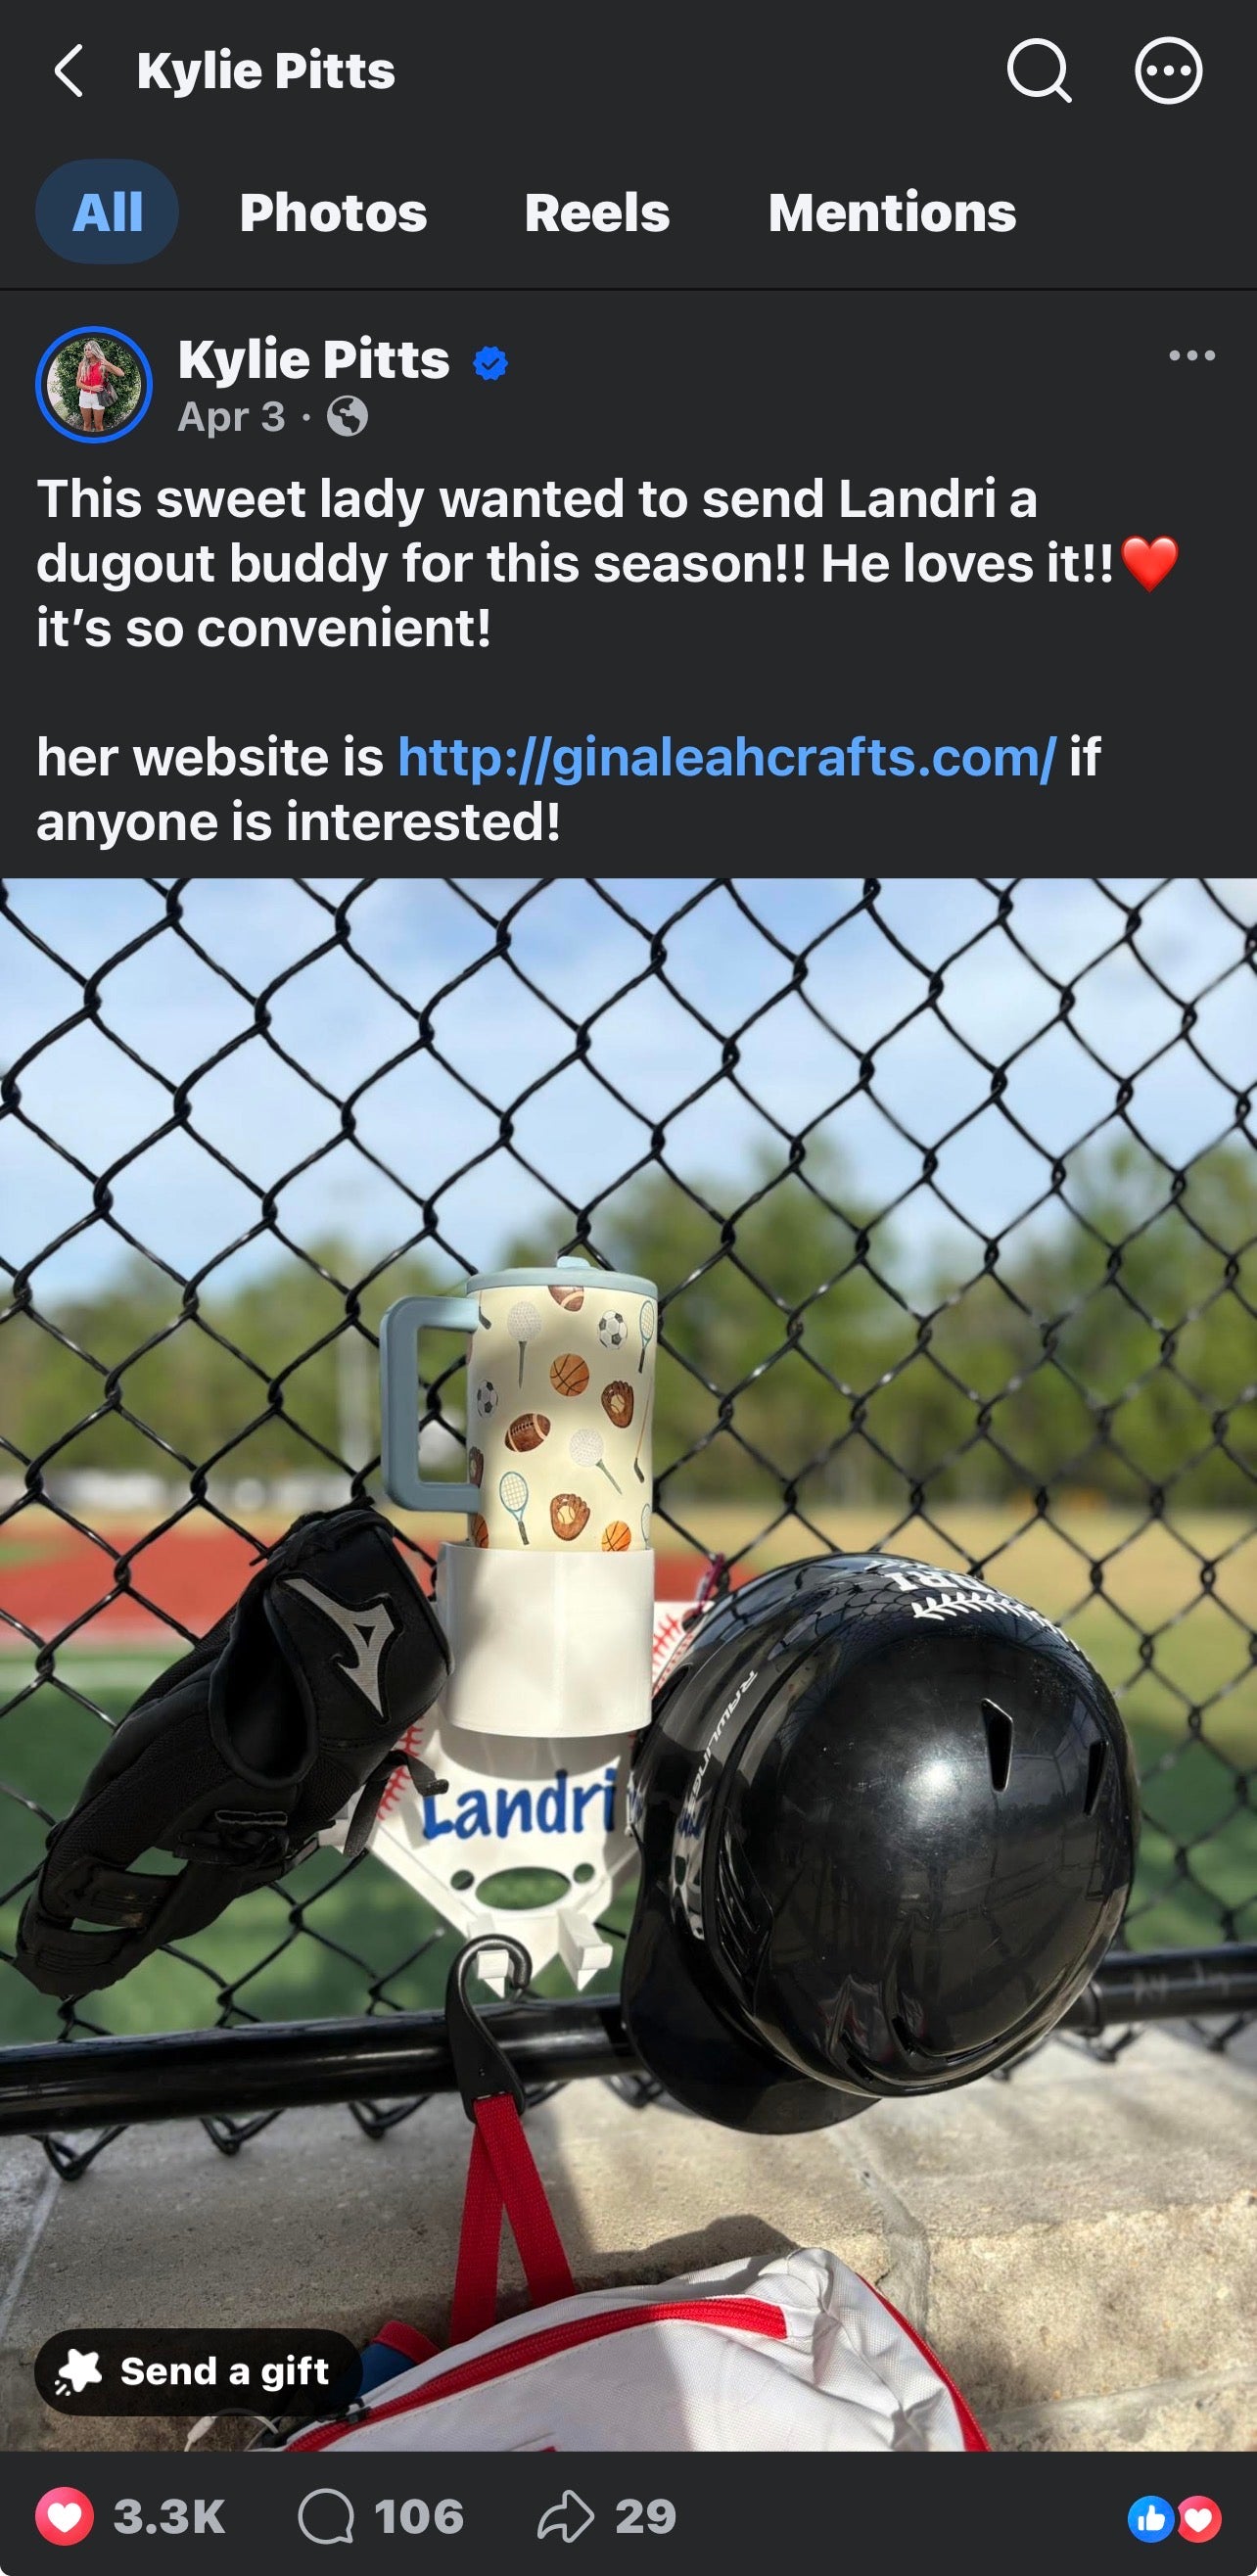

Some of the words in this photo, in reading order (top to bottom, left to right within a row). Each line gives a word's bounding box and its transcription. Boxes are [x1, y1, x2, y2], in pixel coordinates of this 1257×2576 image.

[139, 47, 262, 98] Kylie
[277, 47, 395, 90] Pitts
[72, 192, 141, 231] All
[242, 191, 427, 232] Photos
[527, 191, 670, 232] Reels
[770, 188, 1016, 232] Mentions
[180, 335, 309, 389] Kylie
[325, 335, 449, 379] Pitts
[178, 401, 249, 439] Apr
[262, 401, 285, 432] 3
[37, 476, 141, 518] This
[157, 482, 305, 518] sweet
[322, 478, 425, 527] lady
[439, 478, 623, 518] wanted
[638, 482, 687, 518] to
[703, 478, 822, 518] send
[841, 476, 995, 518] Landri
[1010, 488, 1036, 518] a
[37, 542, 214, 591] dugout
[232, 542, 389, 591] buddy
[402, 542, 473, 583] for
[487, 540, 579, 583] this
[594, 544, 804, 583] season!!
[823, 544, 889, 583] He
[906, 542, 1033, 583] loves
[1048, 540, 1111, 583] it!!
[126, 617, 183, 647] so
[198, 605, 489, 647] convenient!
[39, 734, 118, 776] her
[133, 734, 328, 776] website
[345, 734, 383, 776] is
[400, 734, 1057, 785] http://ginaleahcrafts.com/
[1071, 734, 1101, 776] if
[37, 811, 217, 850] anyone
[233, 799, 271, 841] is
[288, 799, 558, 841] interested!
[423, 1768, 617, 1840] Landri
[115, 2499, 225, 2534] 3.3K
[376, 2499, 463, 2534] 106
[617, 2499, 675, 2534] 29
